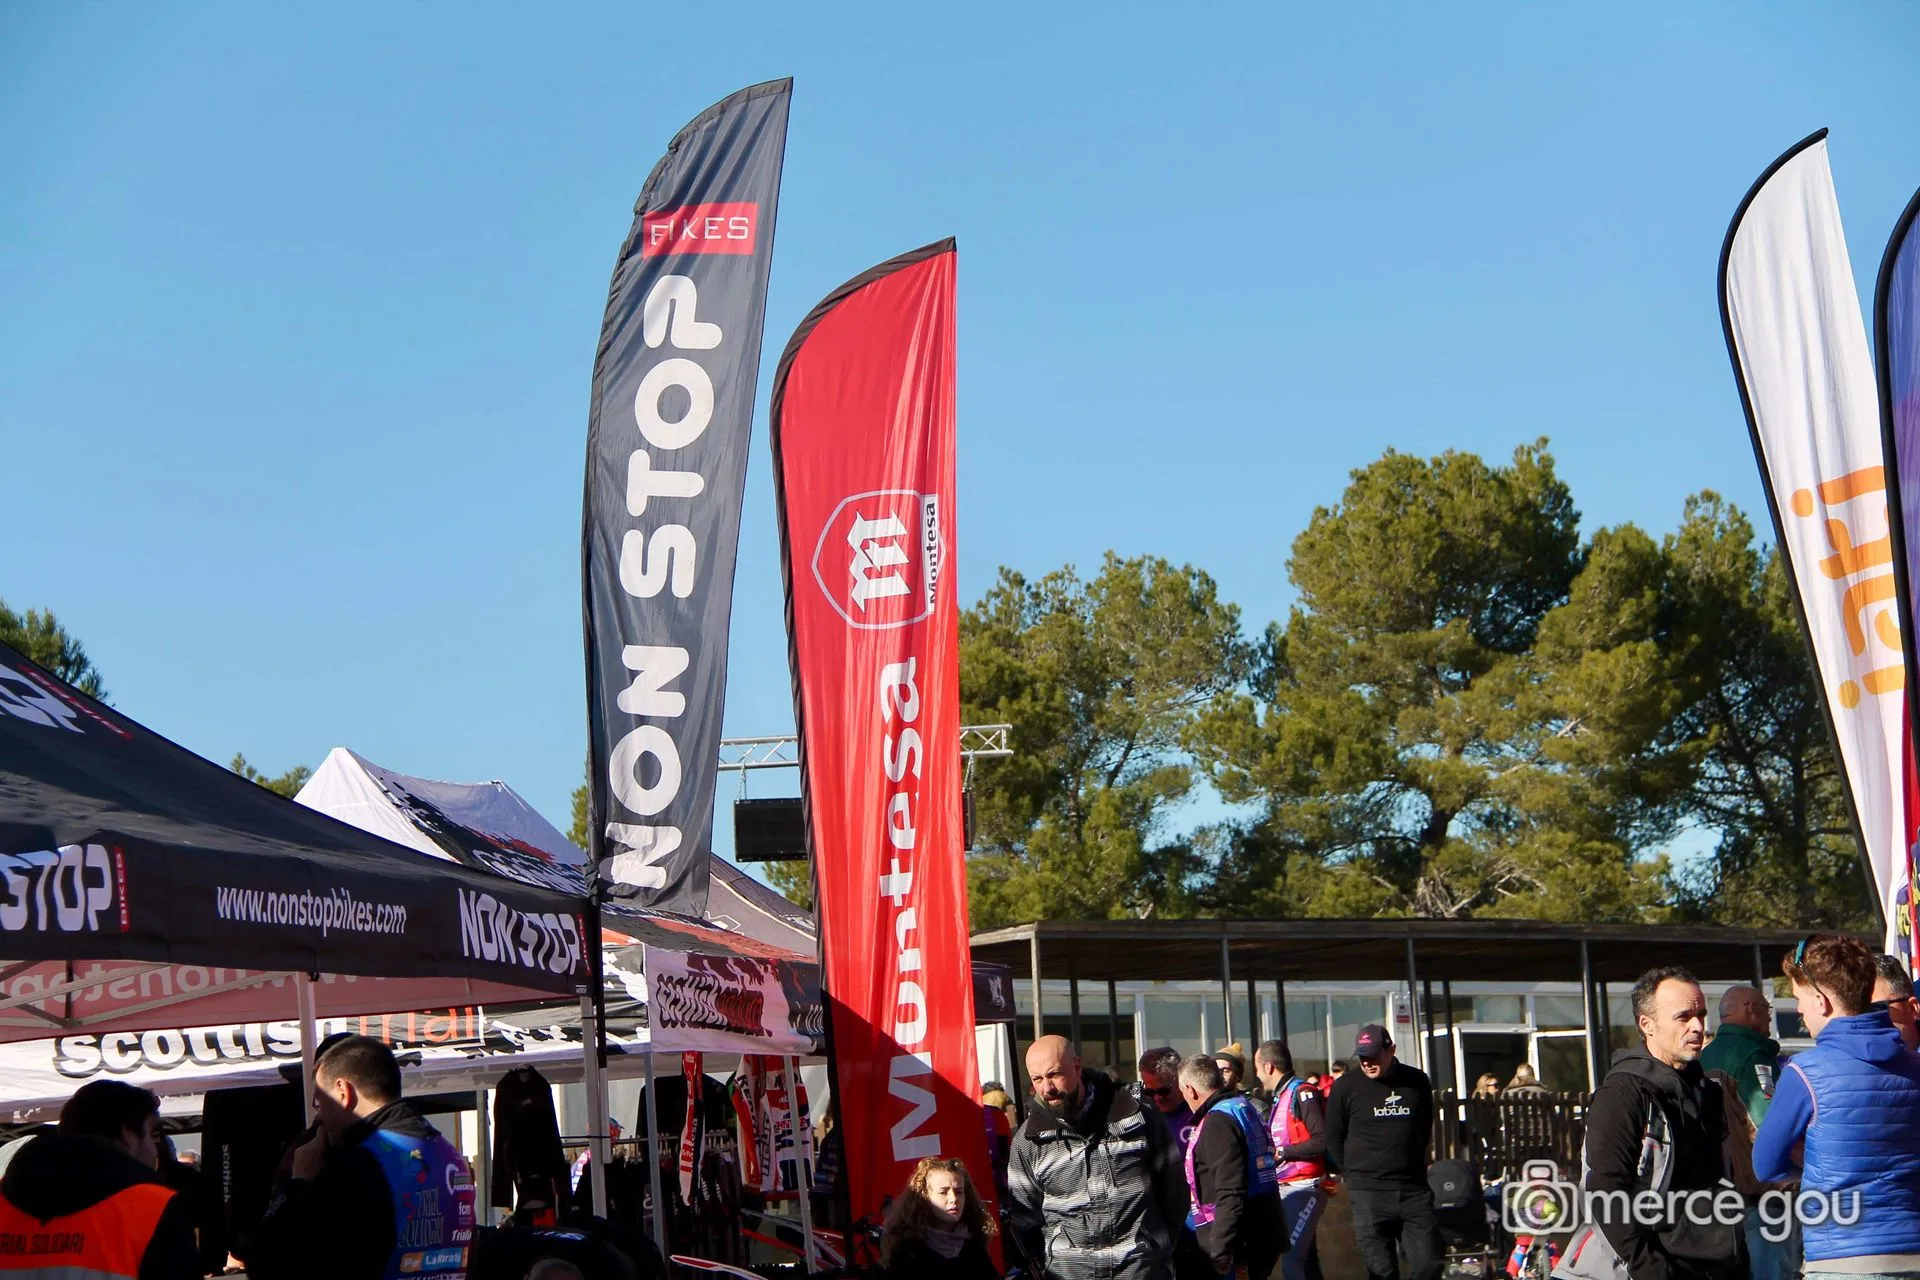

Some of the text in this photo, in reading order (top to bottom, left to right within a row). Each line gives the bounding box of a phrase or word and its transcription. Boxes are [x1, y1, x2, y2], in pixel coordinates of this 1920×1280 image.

[599, 274, 723, 890] NON STOP
[216, 885, 408, 938] www.nonstopbikes.com
[458, 888, 517, 965] NON
[517, 911, 581, 976] STOP
[879, 656, 942, 1162] Montesa
